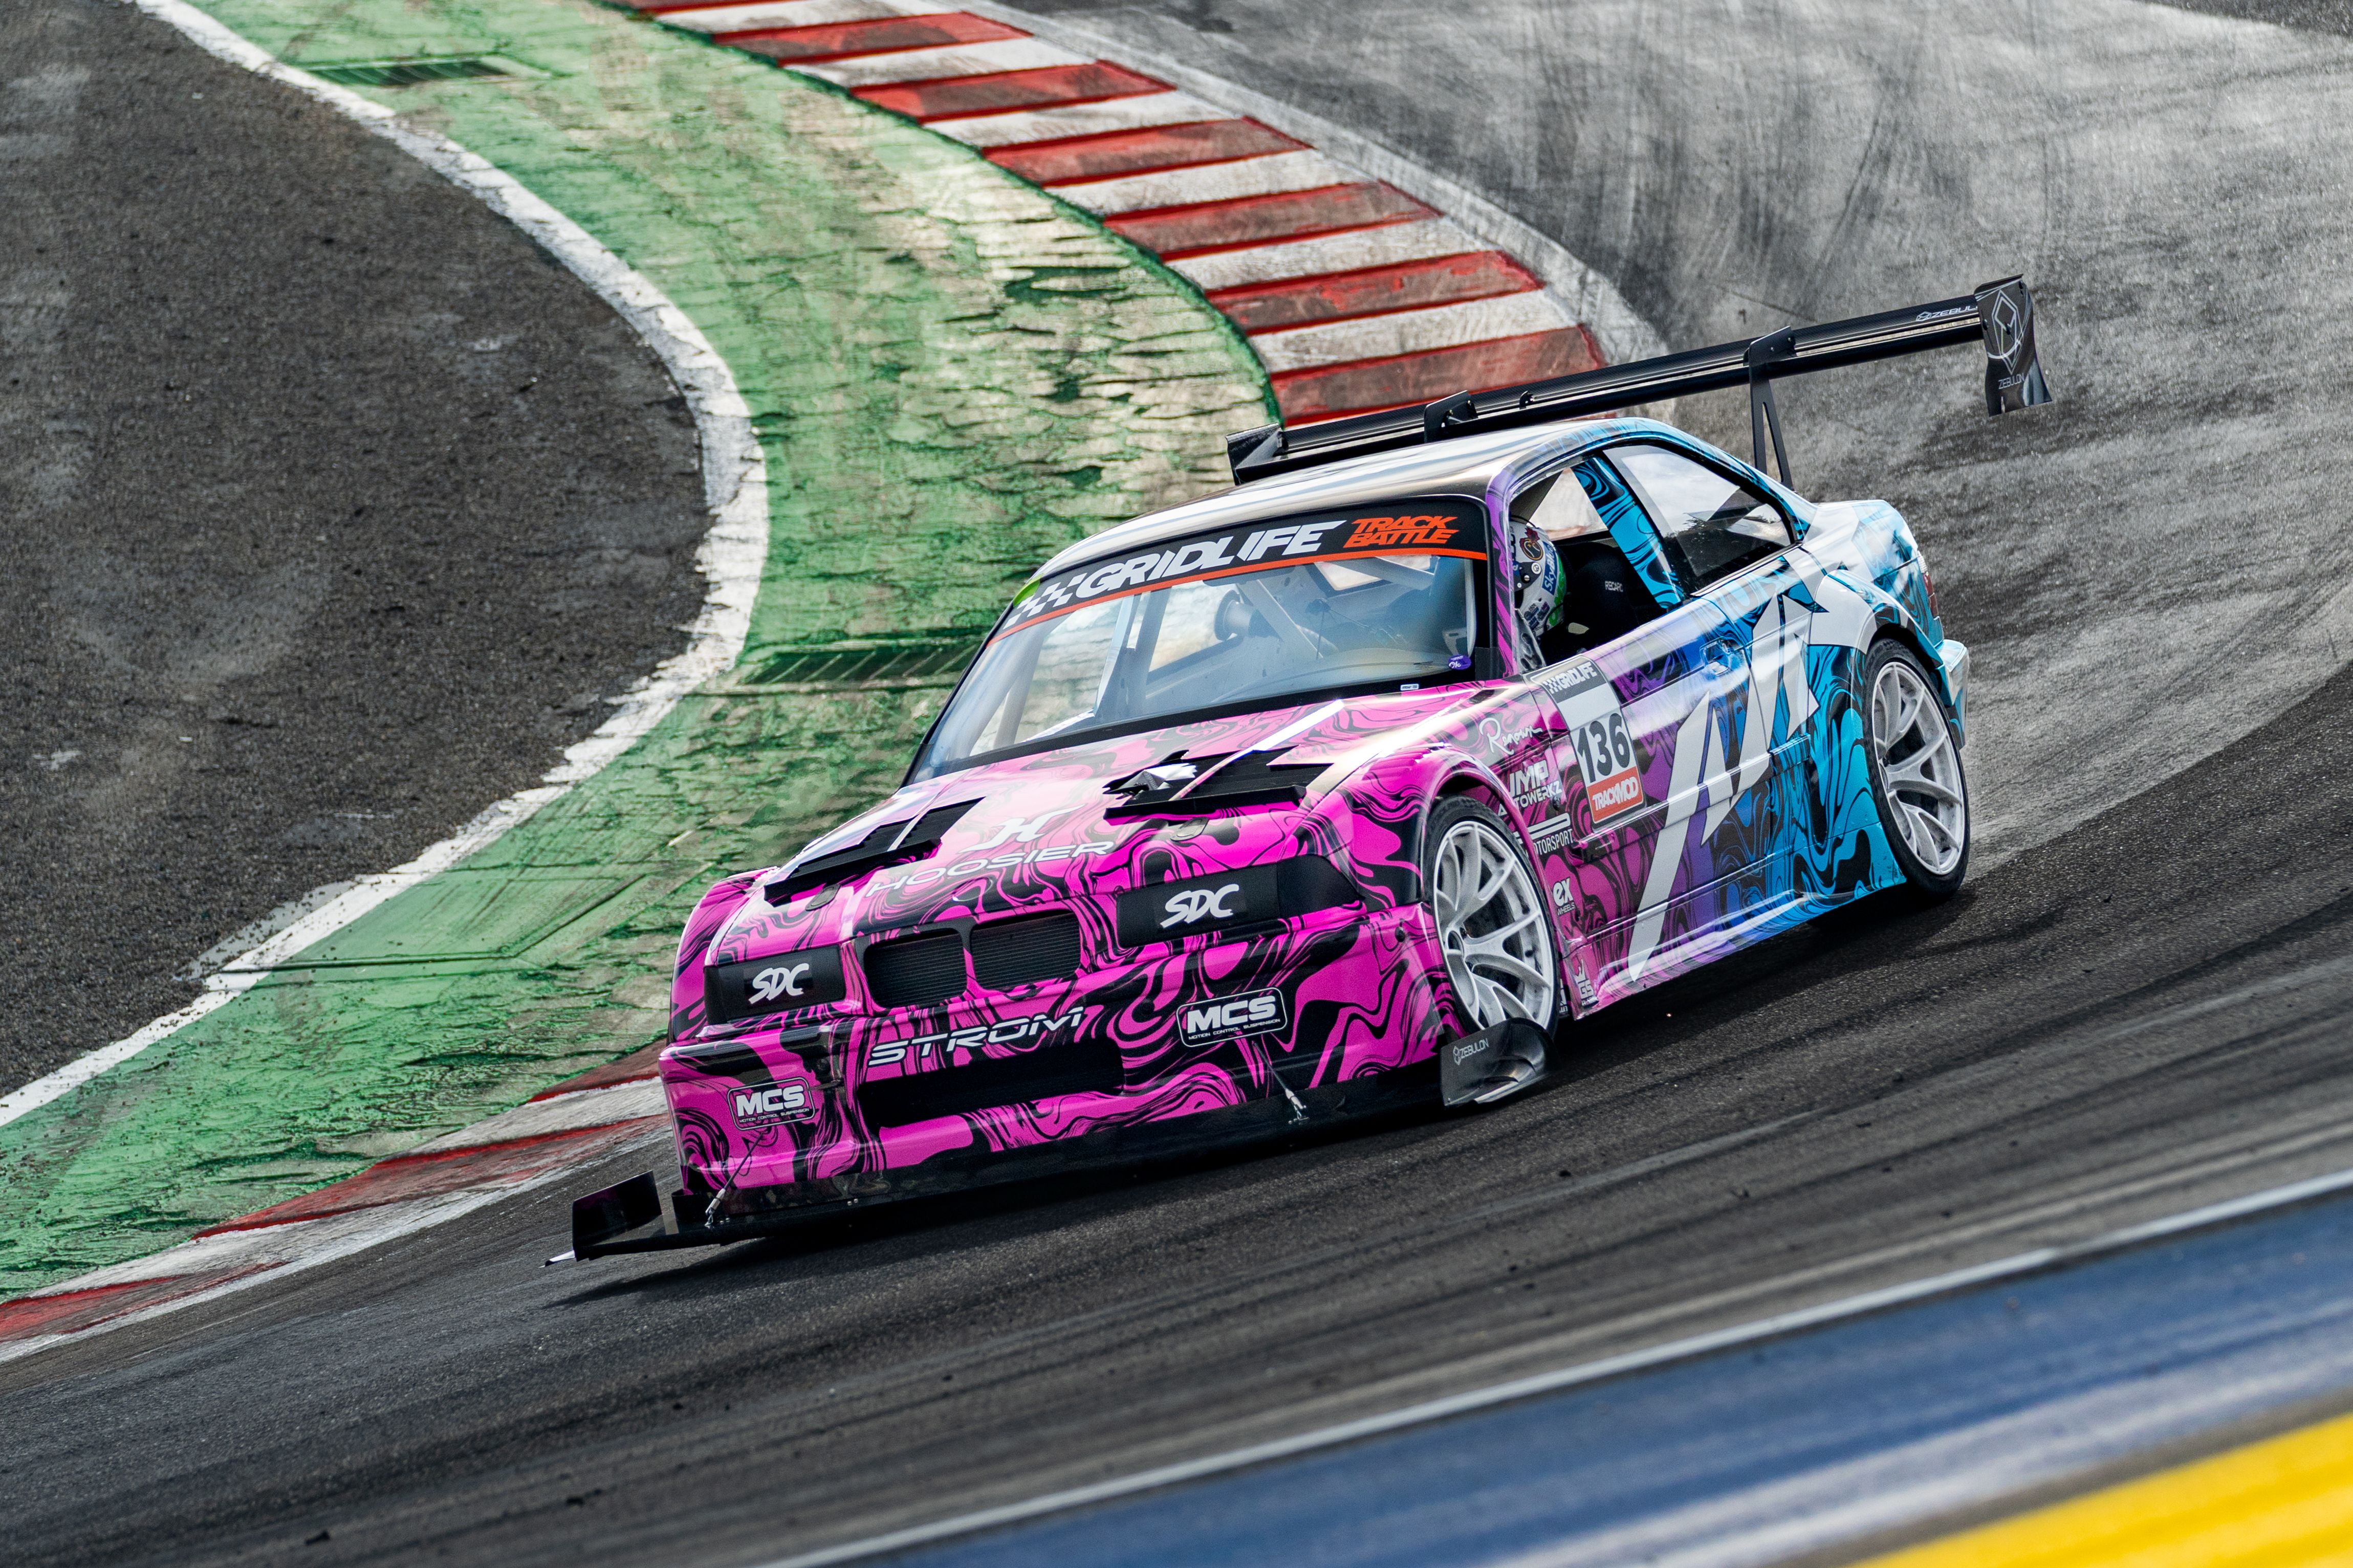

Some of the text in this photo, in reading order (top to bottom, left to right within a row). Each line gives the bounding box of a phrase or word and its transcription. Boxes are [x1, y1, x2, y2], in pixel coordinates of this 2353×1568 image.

[1932, 305, 1978, 318] ZEBUL
[1998, 372, 2025, 389] ZEBULON
[1343, 528, 1460, 548] BATTLE
[1352, 516, 1458, 534] TRACK
[1076, 520, 1347, 598] GRIDLIFE
[1555, 661, 1597, 689] GRIDLIFE
[1577, 713, 1630, 783] 136
[1497, 781, 1562, 816] ATOWERKZ
[1593, 777, 1638, 811] TRACKMOD
[866, 841, 1115, 898] HOOSIER
[1160, 884, 1239, 929] SDC
[1557, 901, 1576, 916] WHEELS
[748, 963, 810, 1004] SDC
[1187, 996, 1276, 1033] MCS
[1213, 1027, 1240, 1035] CONTROL
[1243, 1019, 1280, 1029] SUSPENSION
[868, 1006, 1084, 1066] STROM
[1458, 1038, 1490, 1059] ZEBULON
[736, 1085, 805, 1117] MCS
[781, 1108, 810, 1117] SUSPENSION
